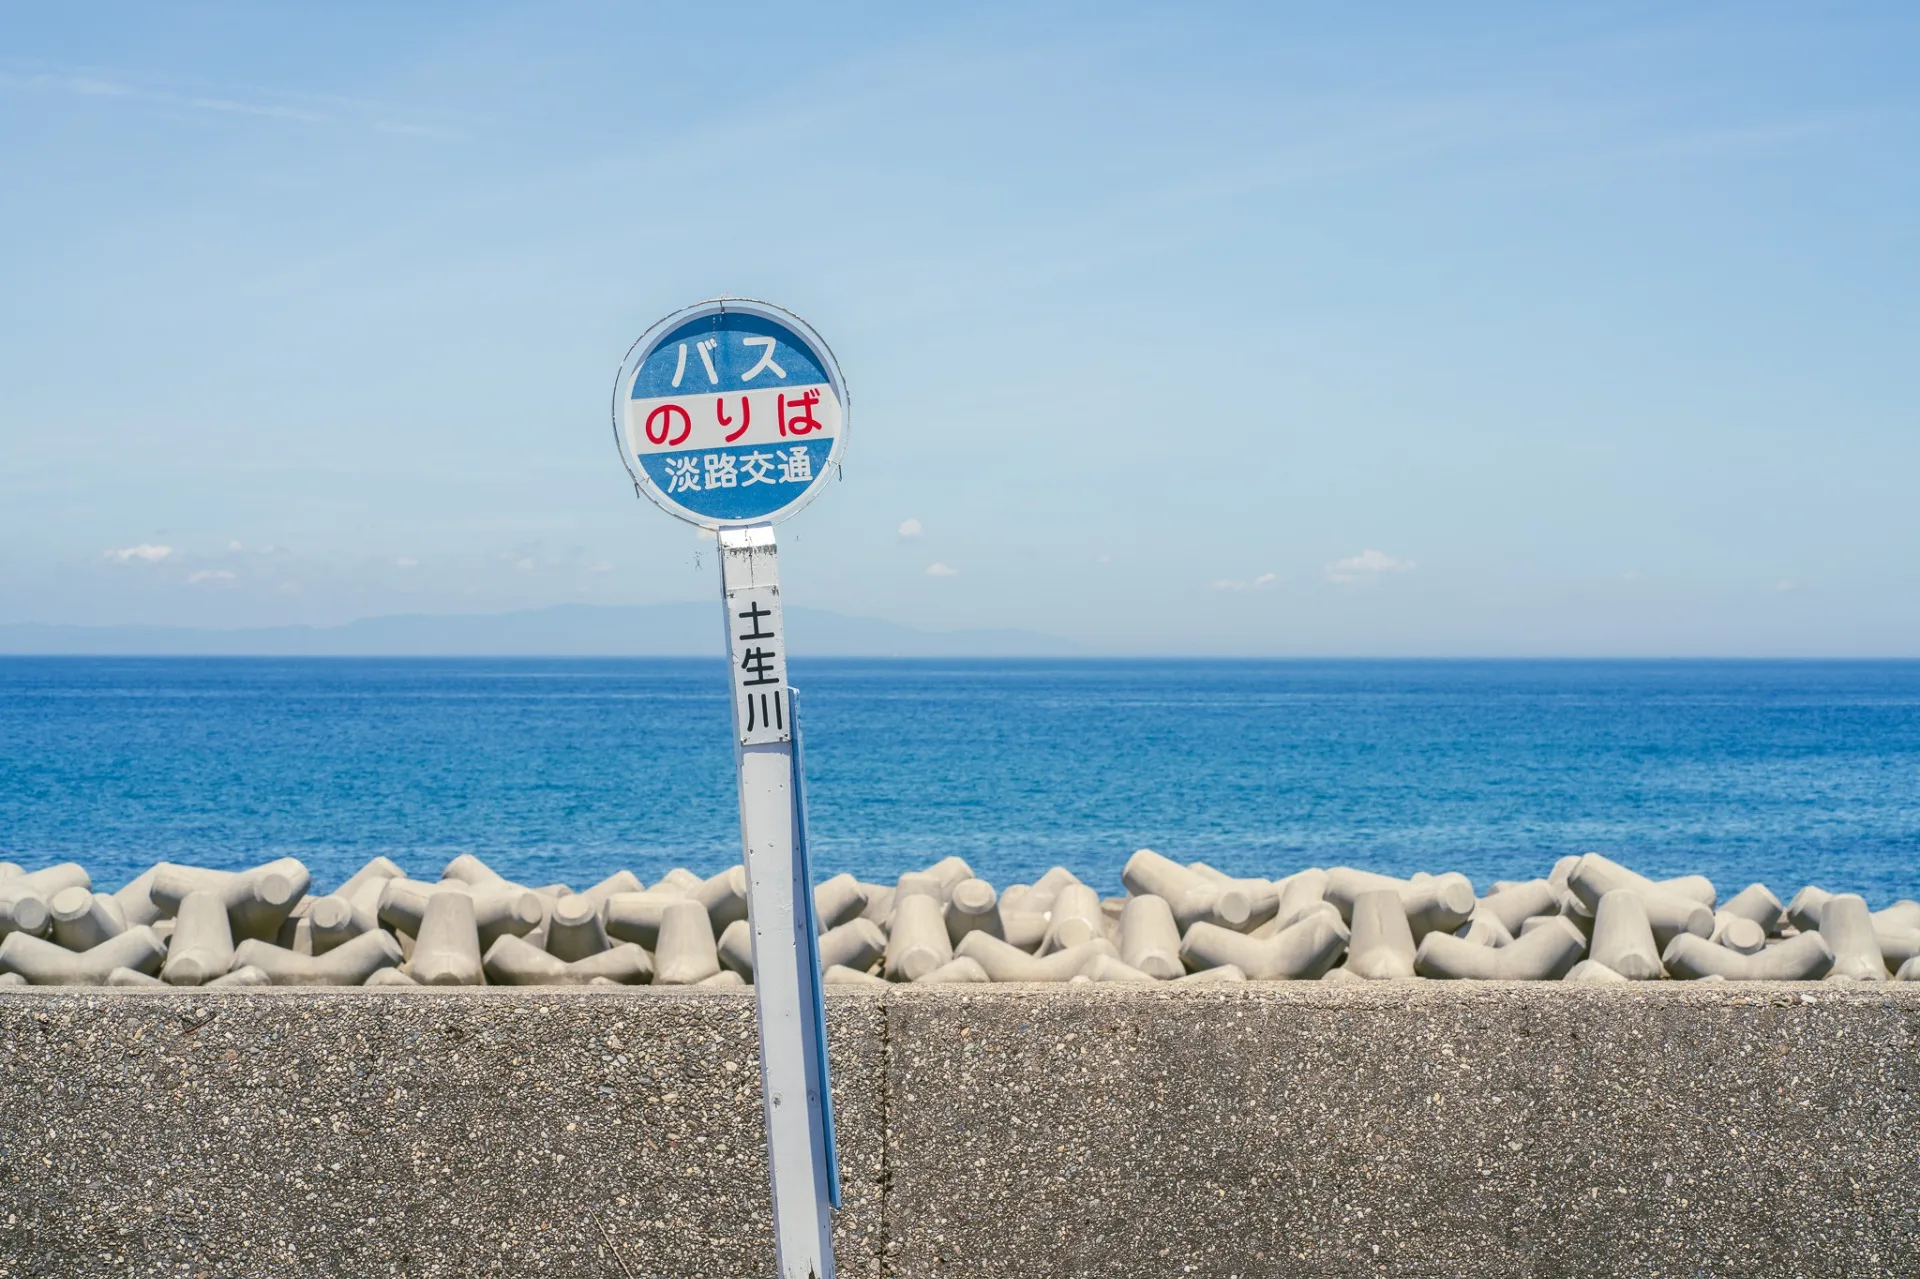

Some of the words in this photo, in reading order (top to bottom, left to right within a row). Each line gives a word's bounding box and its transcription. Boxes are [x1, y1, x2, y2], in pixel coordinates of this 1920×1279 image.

[671, 336, 787, 388] バス
[645, 388, 822, 446] のりば
[664, 446, 813, 493] 淡路交通
[738, 601, 783, 732] 土生川
